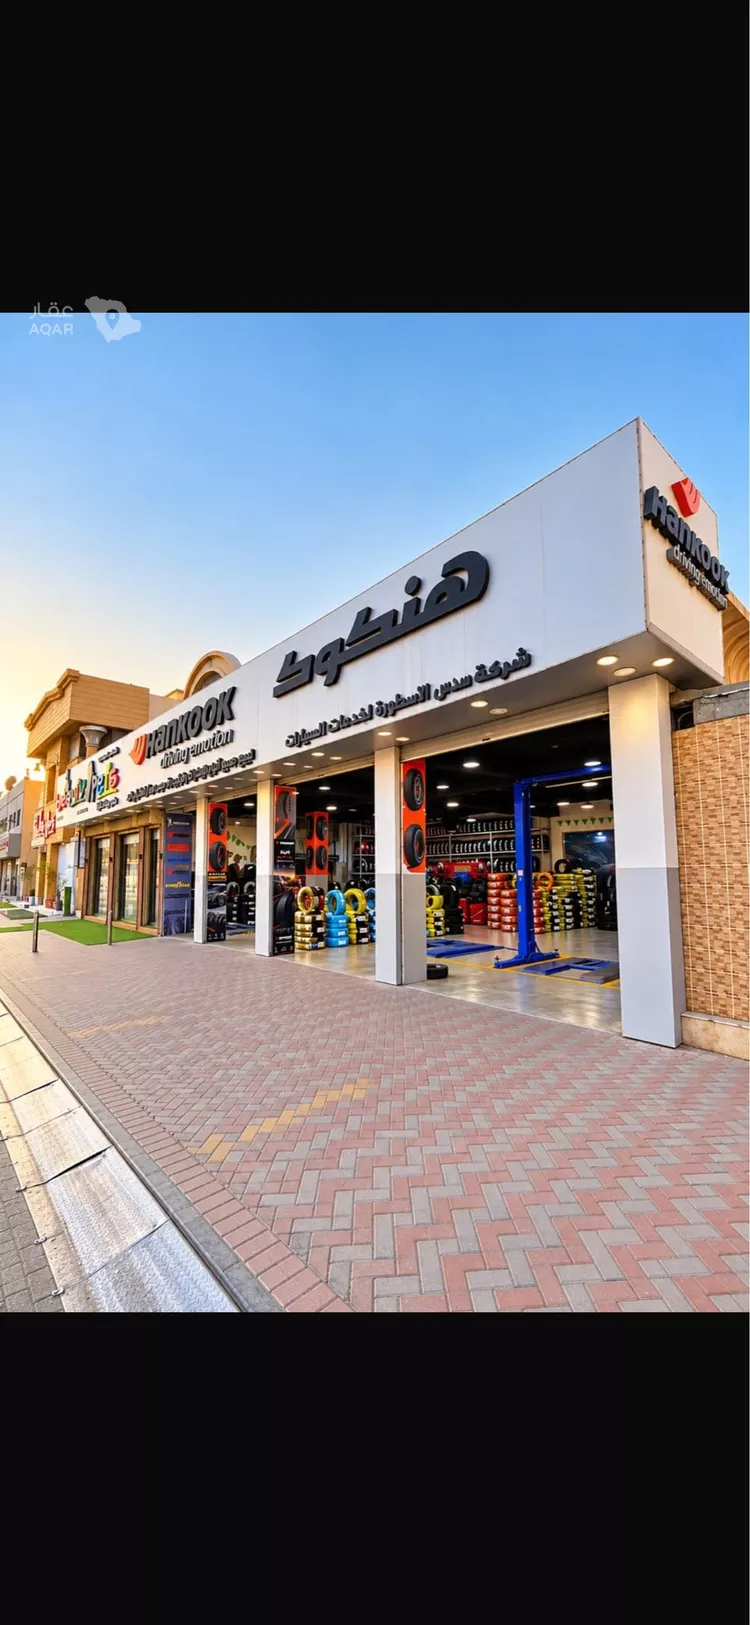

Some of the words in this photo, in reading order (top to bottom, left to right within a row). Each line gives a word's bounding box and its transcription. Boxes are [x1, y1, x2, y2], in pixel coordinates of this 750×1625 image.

[670, 544, 701, 587] driving
[273, 550, 490, 698] هنكوك
[474, 647, 532, 680] شركة
[285, 721, 328, 748] السيارات
[328, 704, 374, 733] لخدمات
[160, 747, 191, 769] driving
[189, 728, 235, 757] emotion
